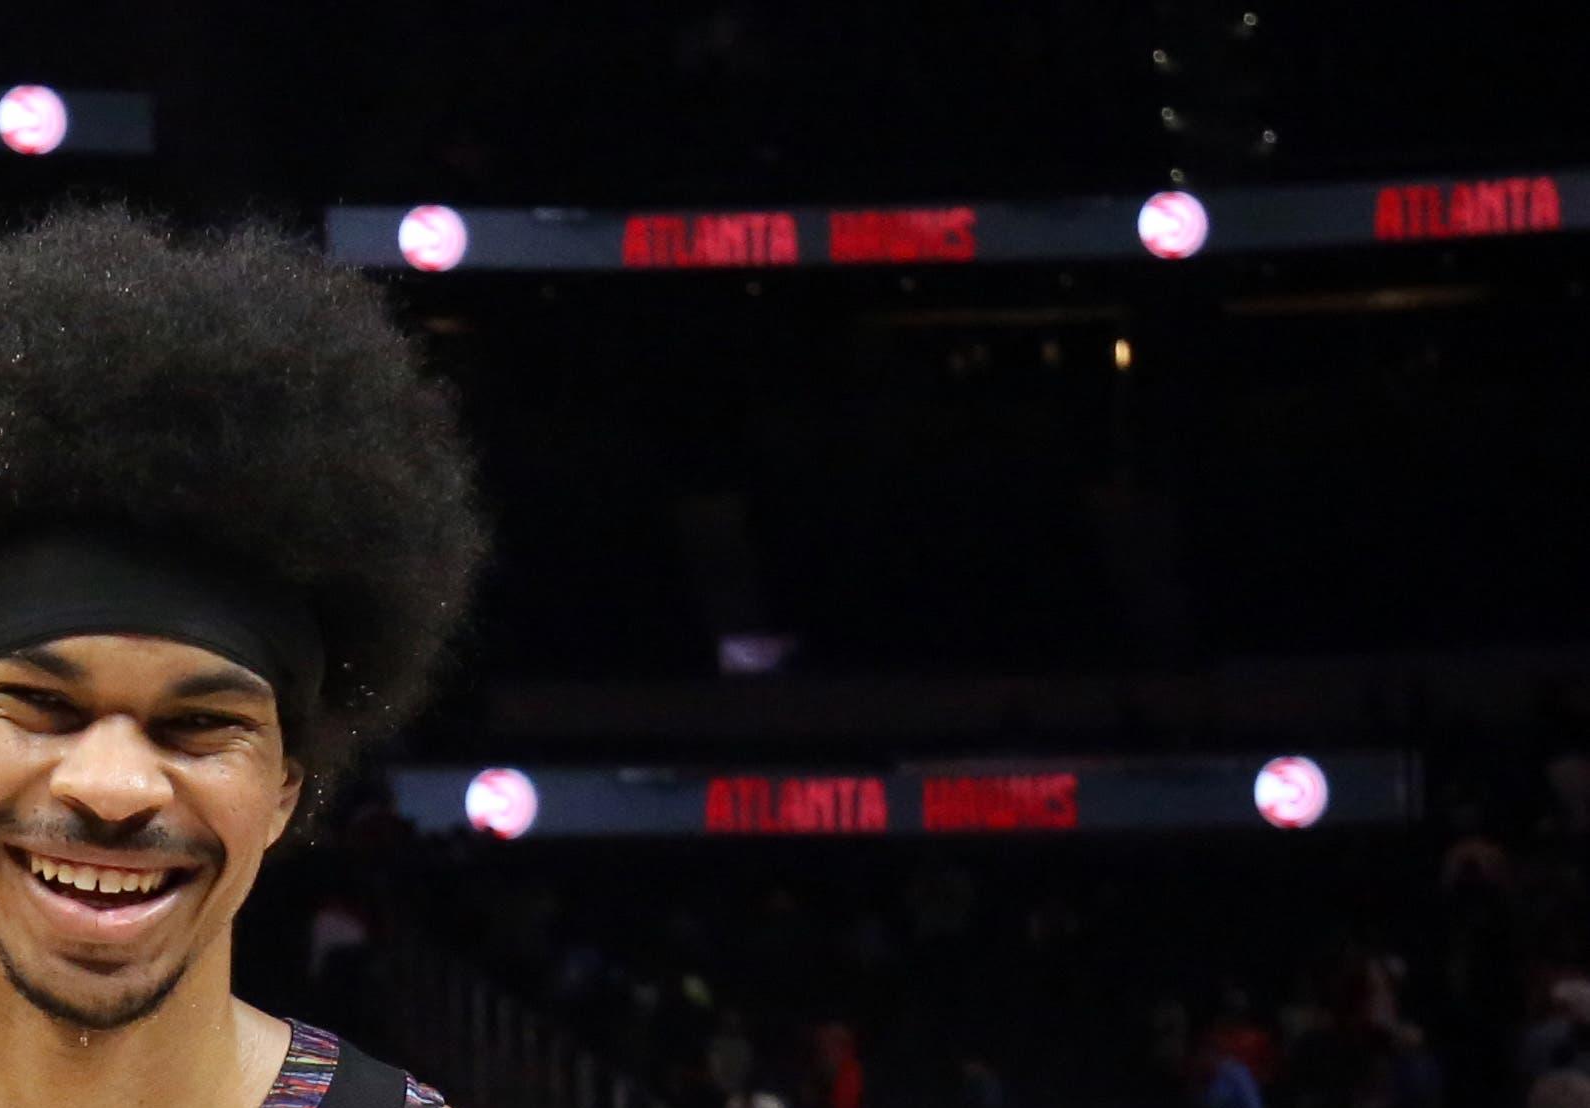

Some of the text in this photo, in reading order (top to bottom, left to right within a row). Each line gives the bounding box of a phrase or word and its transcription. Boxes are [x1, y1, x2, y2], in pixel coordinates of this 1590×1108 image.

[1374, 176, 1561, 239] ATLANTA
[623, 212, 798, 267] ATLANTA
[706, 777, 887, 832] ATLANTA
